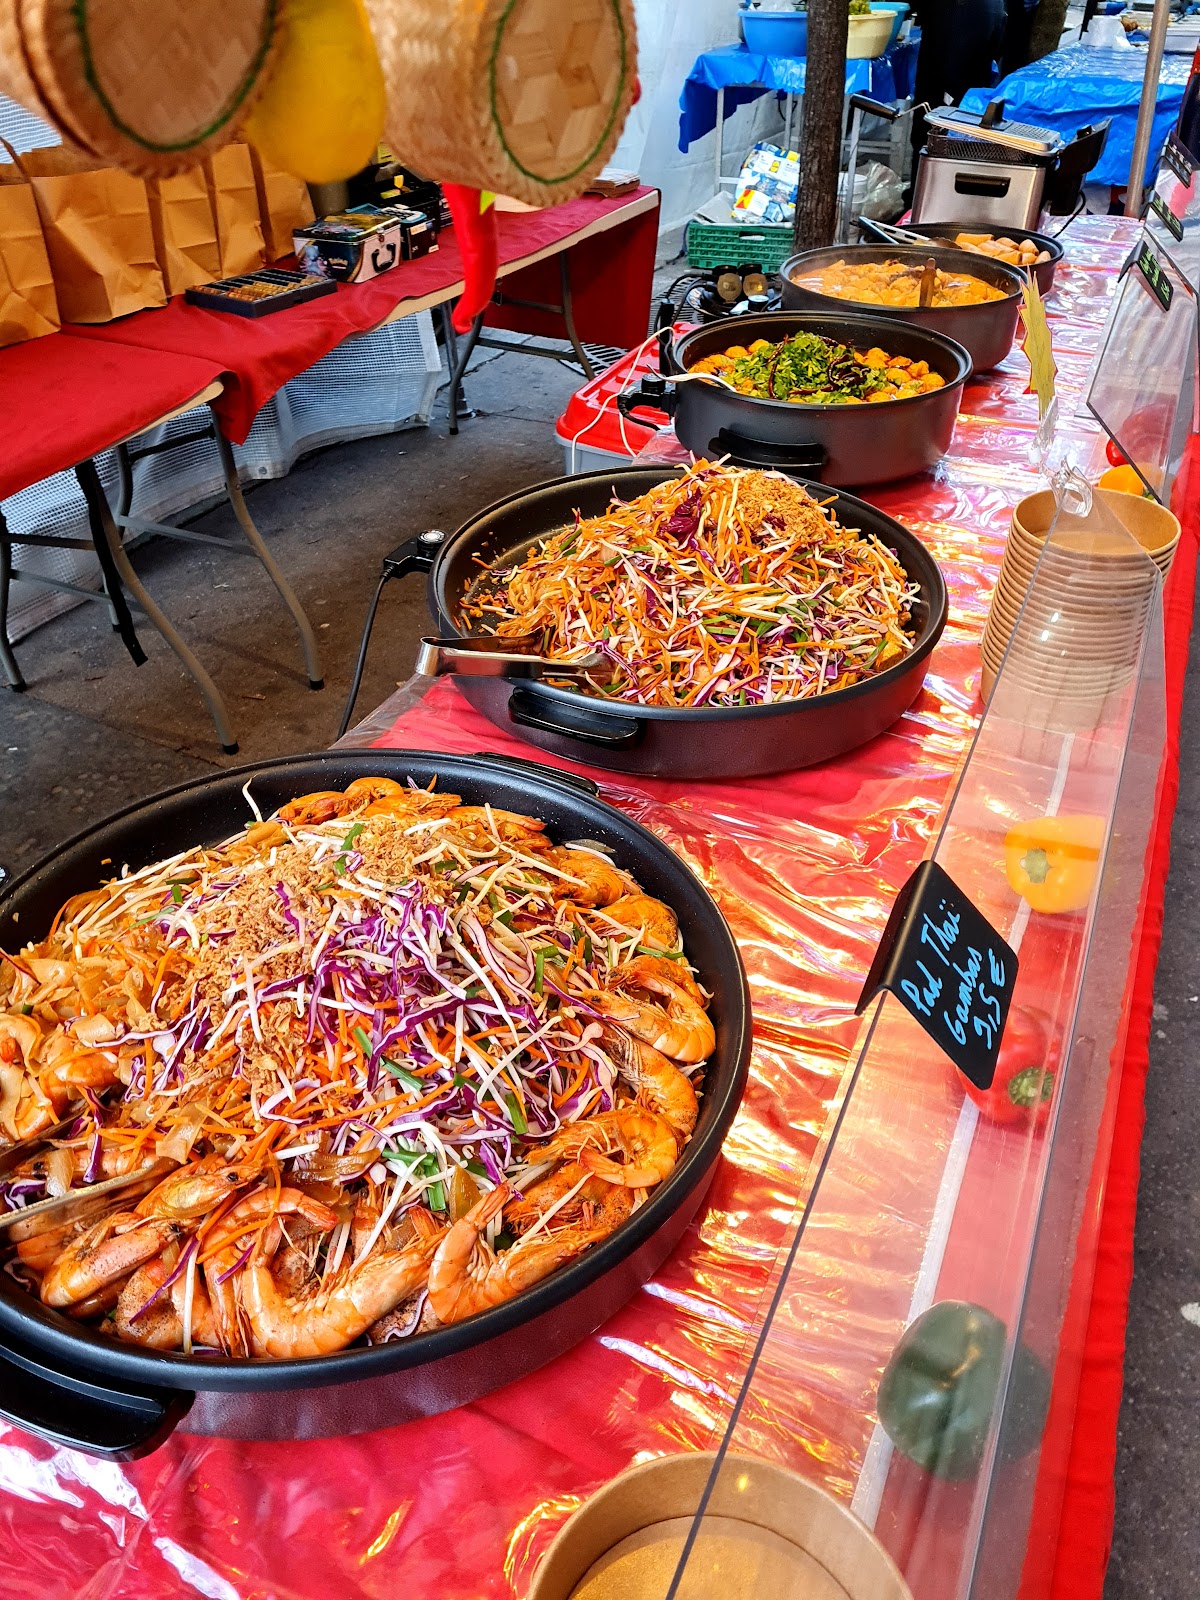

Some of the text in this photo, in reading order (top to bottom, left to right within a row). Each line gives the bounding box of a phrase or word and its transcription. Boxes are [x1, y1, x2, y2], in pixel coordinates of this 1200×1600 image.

[901, 960, 943, 1016] Pad
[944, 947, 983, 1046] Gambas
[974, 983, 1001, 1050] 9,5
